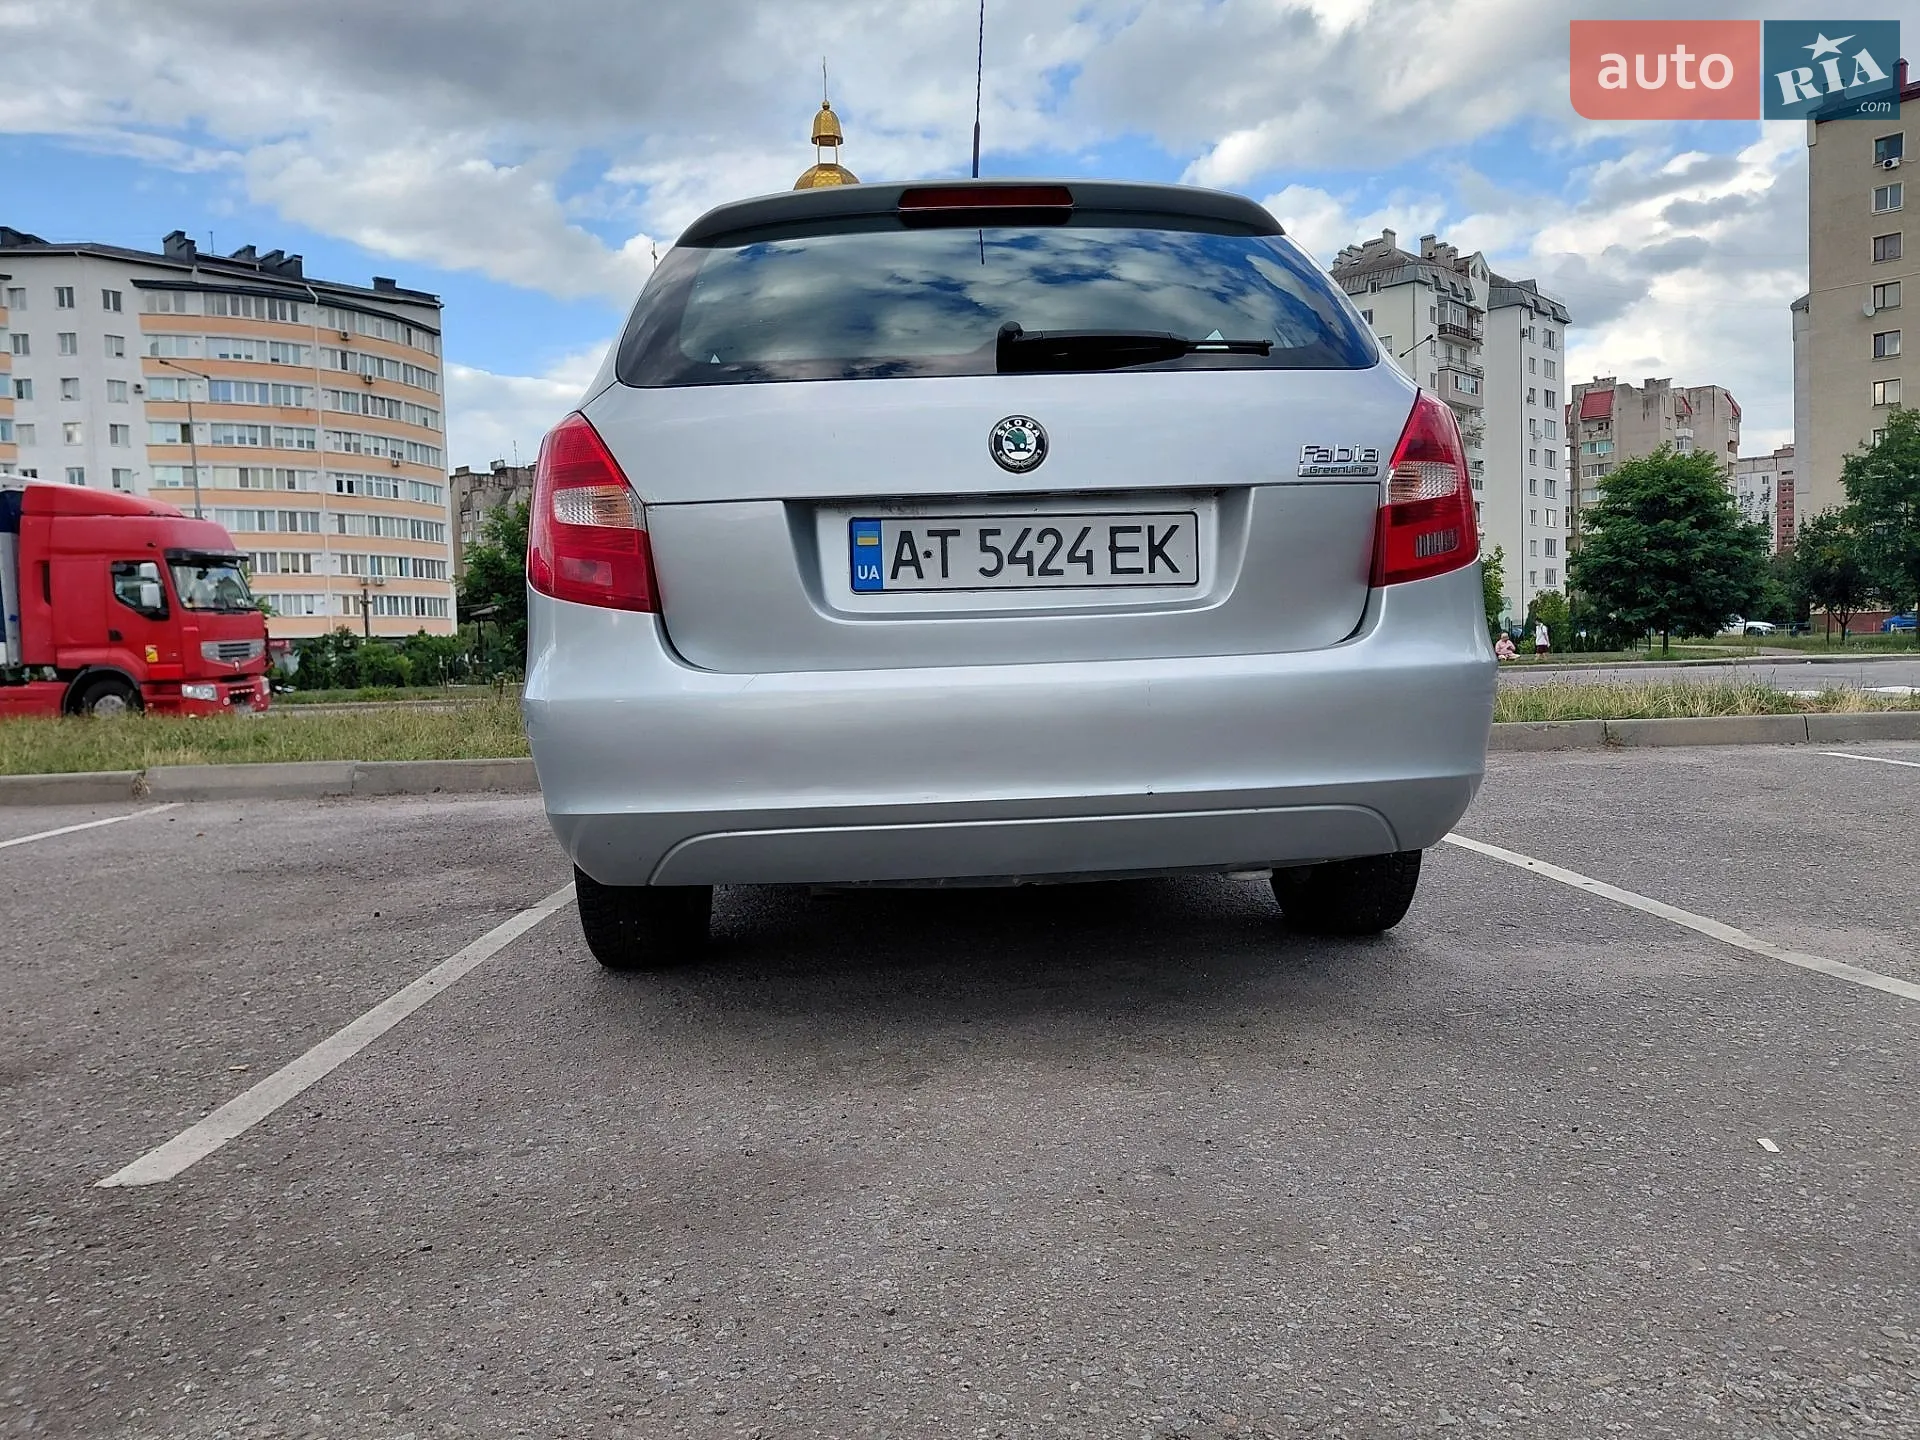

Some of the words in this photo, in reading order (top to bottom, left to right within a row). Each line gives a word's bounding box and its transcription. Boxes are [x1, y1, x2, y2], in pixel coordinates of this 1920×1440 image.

[1299, 443, 1379, 463] Fabia
[890, 529, 961, 580] AT
[978, 526, 1094, 578] 5424
[1109, 524, 1180, 575] EK
[857, 564, 880, 580] UA
